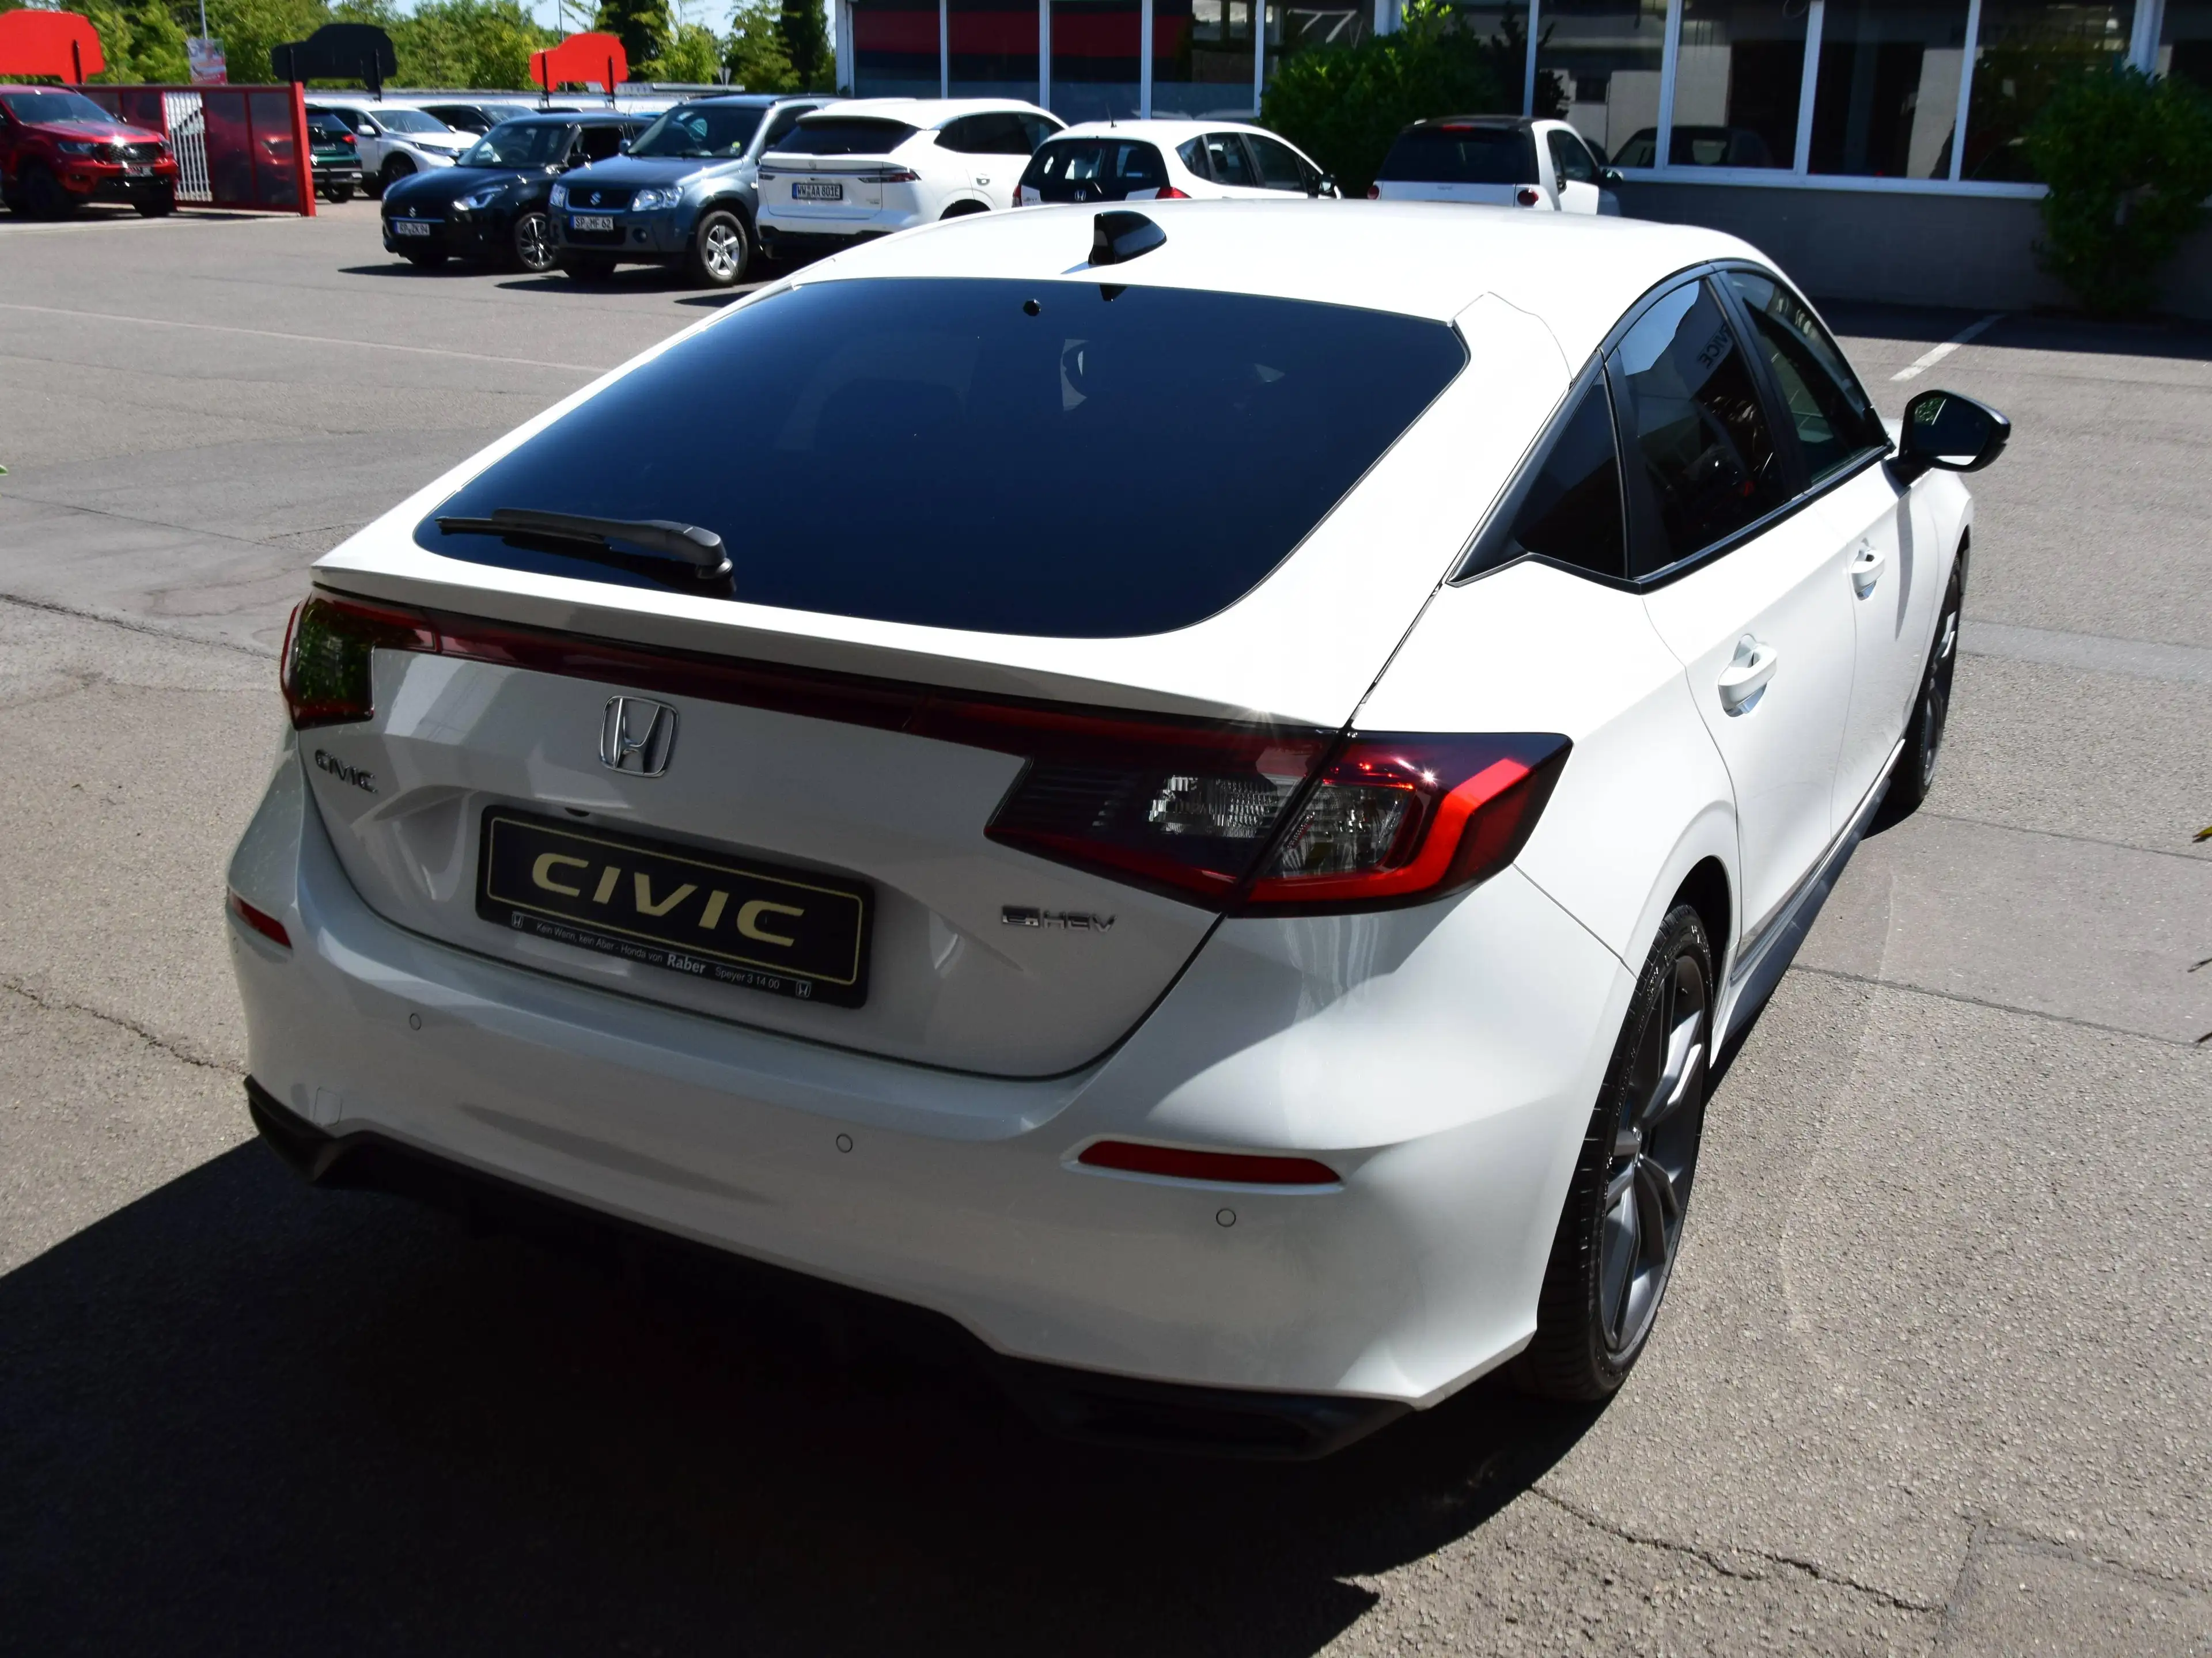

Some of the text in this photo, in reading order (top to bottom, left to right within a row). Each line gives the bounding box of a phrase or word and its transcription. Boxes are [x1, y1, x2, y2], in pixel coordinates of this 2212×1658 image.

[315, 749, 378, 792] CIVIC
[532, 852, 805, 947] CIVIC
[536, 922, 553, 934] Kein
[554, 928, 577, 942] Wenn,
[579, 933, 594, 945] kein
[596, 938, 614, 951] Aber
[620, 944, 646, 959] Honda
[648, 952, 663, 962] von
[666, 954, 707, 974] Raber
[715, 966, 745, 982] Speyer
[747, 974, 753, 984] 3
[756, 976, 766, 986] 14
[768, 978, 780, 989] 00
